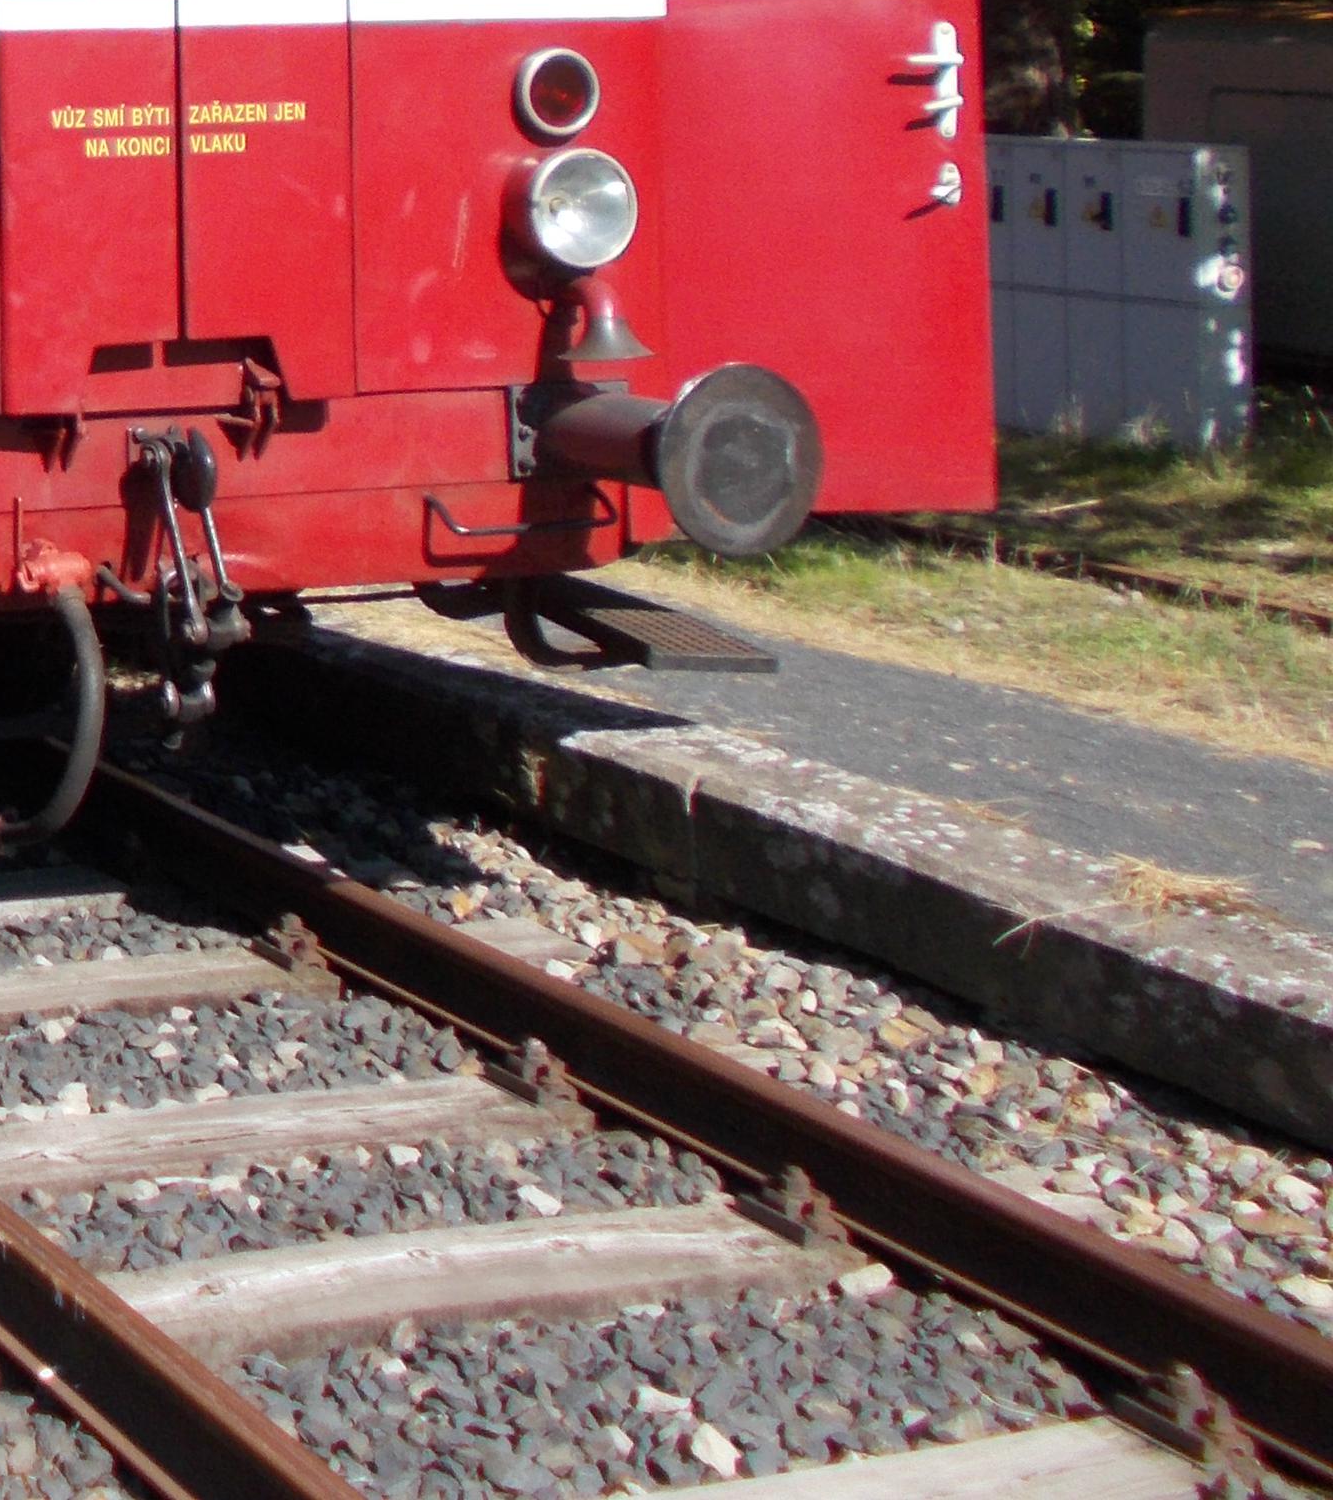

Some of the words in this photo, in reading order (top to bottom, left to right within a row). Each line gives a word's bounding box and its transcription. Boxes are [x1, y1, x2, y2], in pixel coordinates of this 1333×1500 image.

[51, 105, 86, 128] VŮZ
[93, 104, 125, 127] SMÍ
[133, 103, 170, 126] BÝTI
[188, 100, 268, 124] ZAŘAZEN
[274, 102, 306, 122] JEN
[86, 138, 110, 158] NA
[116, 136, 170, 156] KONCI
[190, 133, 247, 153] VLAKU
